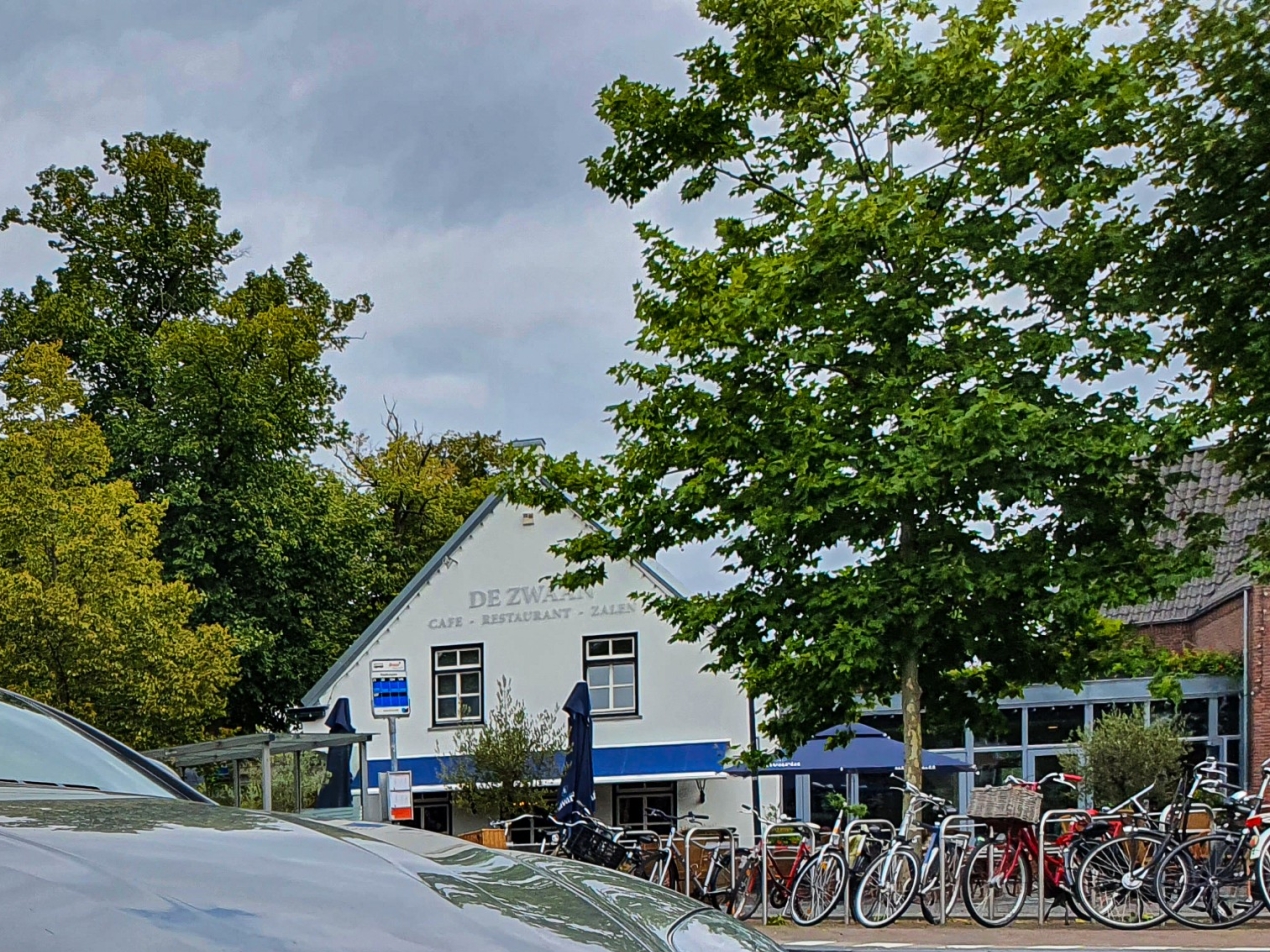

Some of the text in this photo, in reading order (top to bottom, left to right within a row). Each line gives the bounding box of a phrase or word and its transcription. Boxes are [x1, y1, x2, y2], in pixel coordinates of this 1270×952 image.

[469, 588, 501, 609] DE
[481, 608, 572, 625] RESTAURANT
[591, 602, 637, 617] ZALEN
